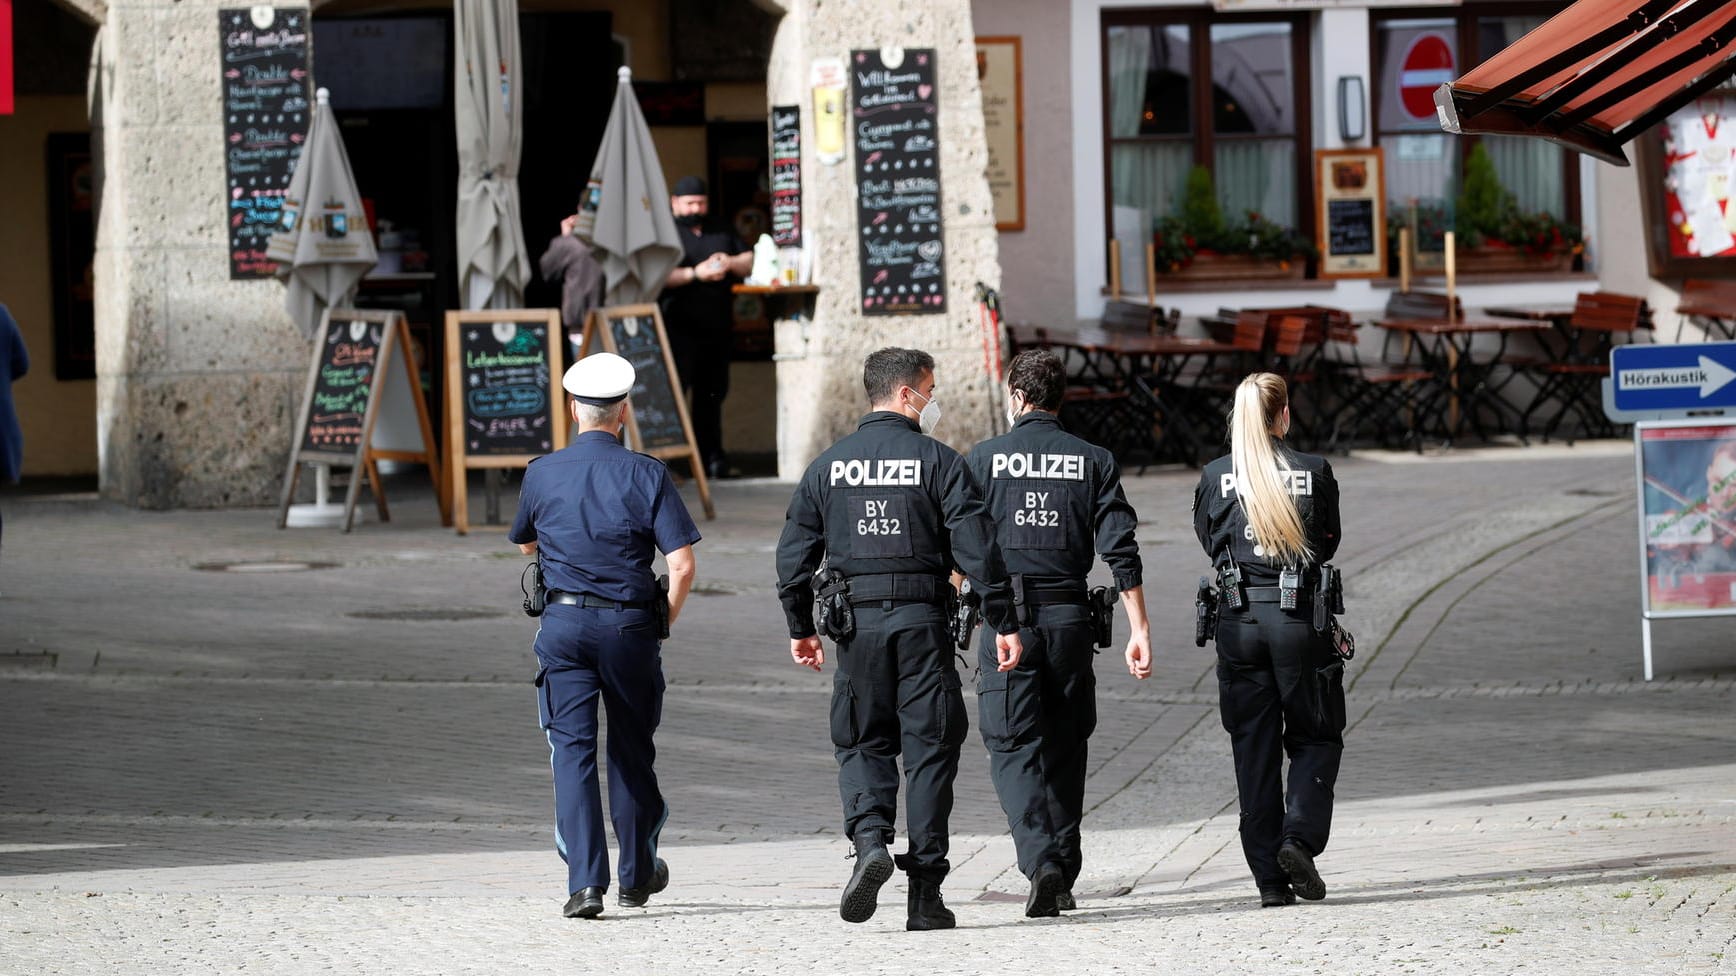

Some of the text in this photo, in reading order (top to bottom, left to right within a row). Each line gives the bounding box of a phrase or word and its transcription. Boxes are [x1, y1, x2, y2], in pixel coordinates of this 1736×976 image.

[1623, 371, 1709, 387] Hörakustik
[830, 459, 921, 487] POLIZEI
[992, 453, 1085, 480] POLIZEI
[1220, 471, 1313, 498] PZEI
[1025, 492, 1049, 508] BY
[866, 501, 888, 517] BY
[1015, 510, 1059, 527] 6432
[857, 519, 902, 535] 6432
